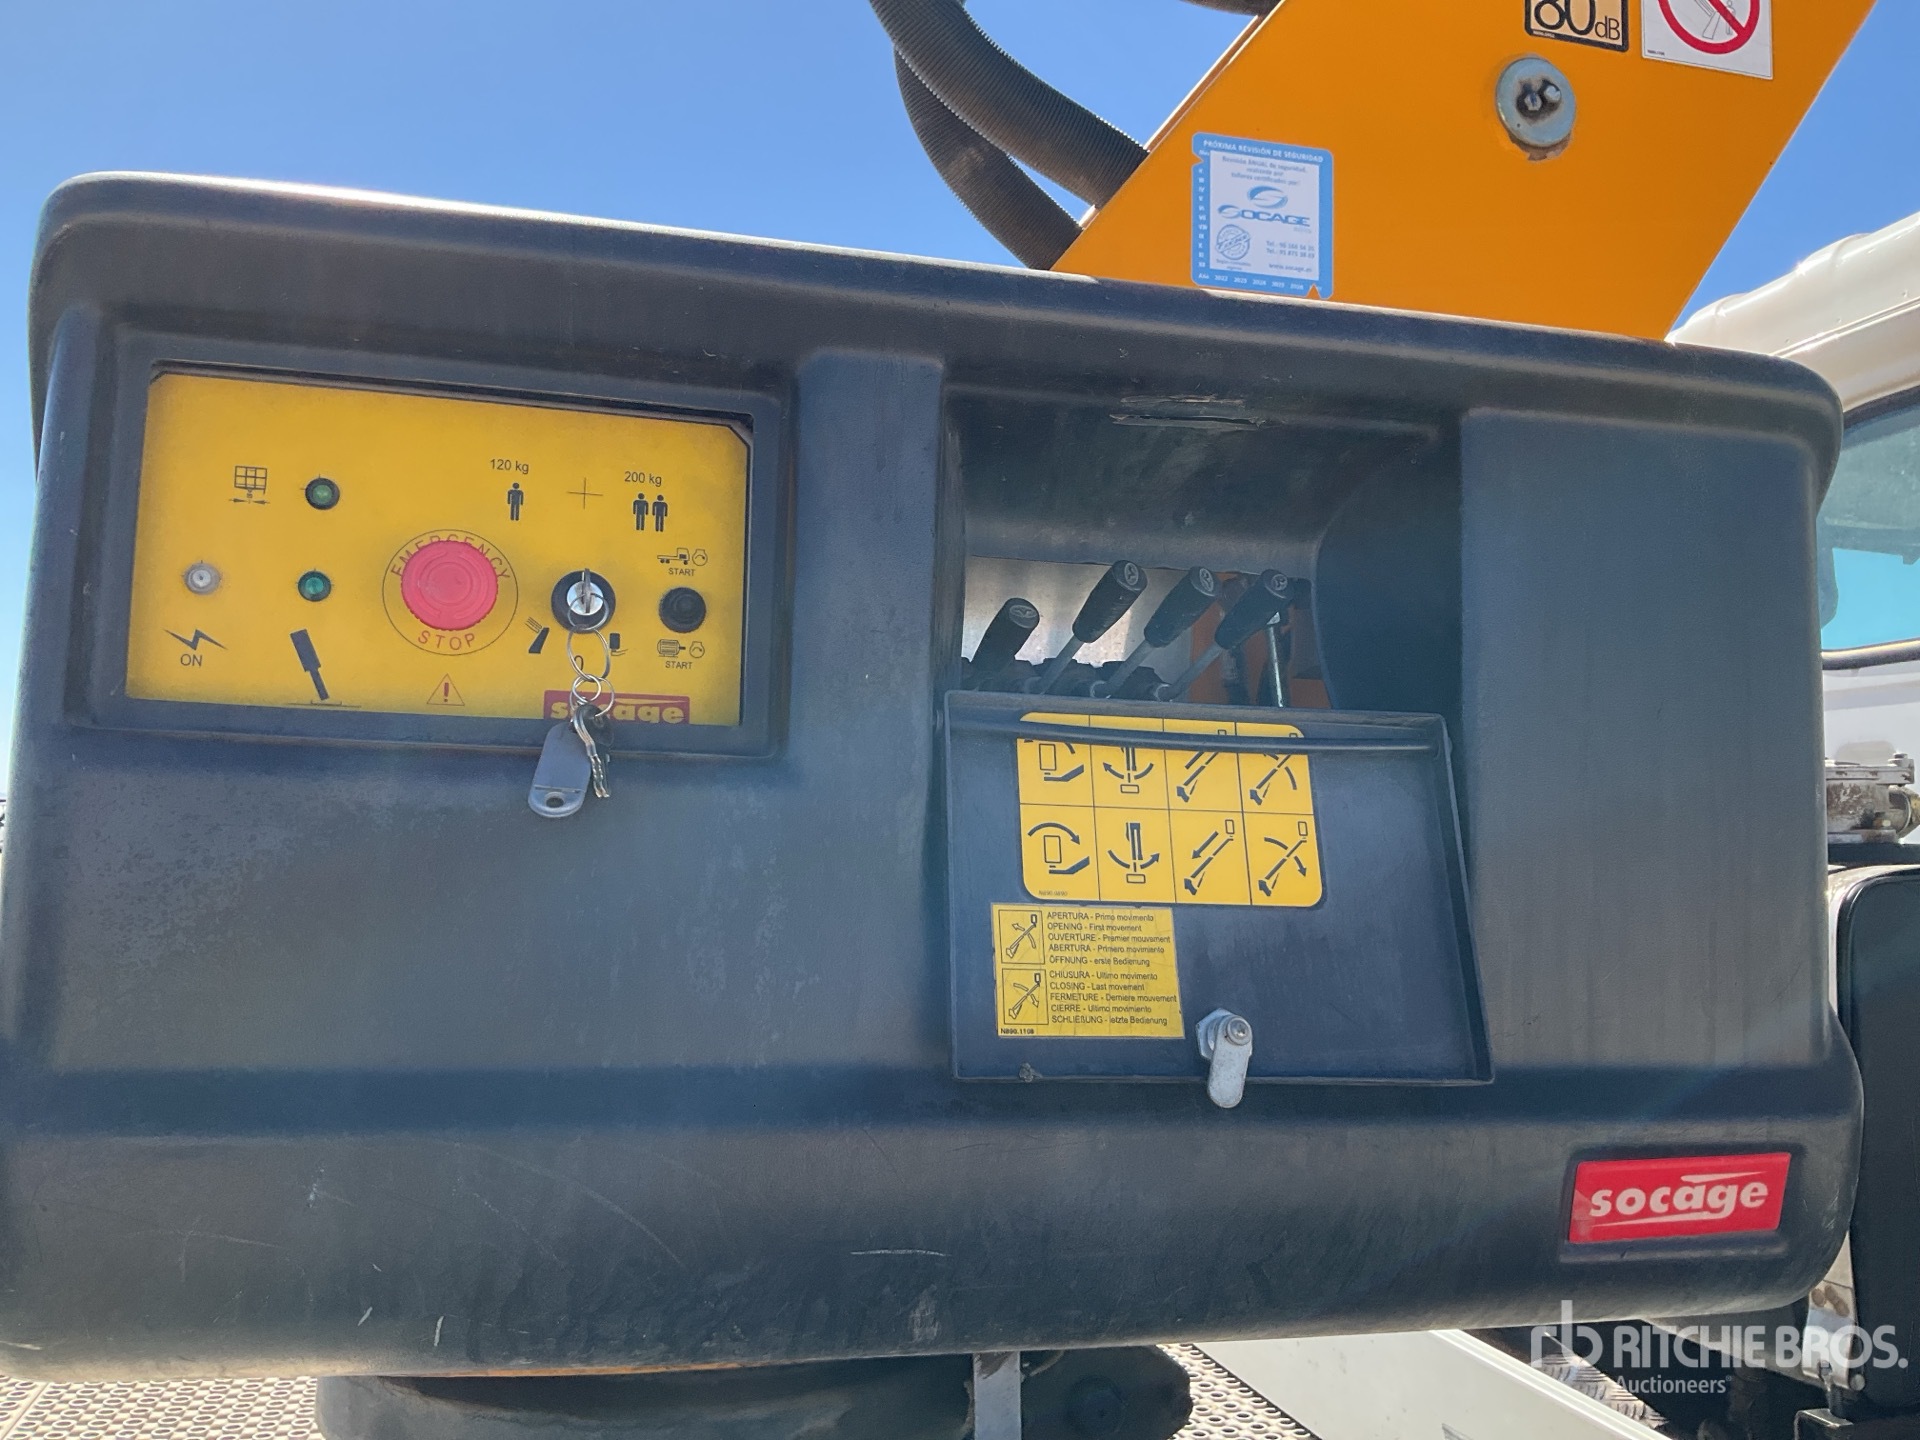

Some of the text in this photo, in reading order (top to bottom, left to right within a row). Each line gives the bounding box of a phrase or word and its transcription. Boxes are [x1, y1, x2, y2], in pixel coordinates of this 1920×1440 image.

[1203, 139, 1324, 163] PRÓXIMA REVISIÓN DE SEGURIDAD
[490, 458, 530, 475] 120 kg
[624, 471, 662, 487] 200 kg
[668, 567, 695, 577] START
[418, 630, 475, 651] STOP
[180, 653, 203, 667] ON
[665, 660, 693, 670] START
[551, 701, 686, 724] sage
[1047, 911, 1089, 920] APERTURA
[1095, 913, 1115, 921] Primo
[1117, 913, 1154, 921] movimento
[1047, 922, 1083, 931] OPENING
[1089, 923, 1105, 931] First
[1106, 924, 1142, 932] movement
[1048, 933, 1096, 941] OUVERTURE
[1102, 934, 1130, 942] Premier
[1131, 935, 1170, 943] mouvement
[1048, 944, 1091, 952] ABERTURA
[1097, 945, 1125, 953] Primero
[1094, 956, 1111, 965] erste
[1113, 957, 1150, 967] Bedienung
[1049, 970, 1090, 979] CHIUSURA
[1120, 972, 1158, 980] movimento
[1049, 982, 1086, 990] CLOSING
[1091, 983, 1107, 991] Last
[1050, 993, 1099, 1001] FERMETURE
[1137, 994, 1177, 1003] mouvement
[1051, 1004, 1081, 1012] CIERRE
[1112, 1005, 1152, 1013] movimiento
[1109, 1015, 1128, 1024] letzte
[1130, 1016, 1168, 1026] Bedienung
[1589, 1180, 1769, 1221] socage
